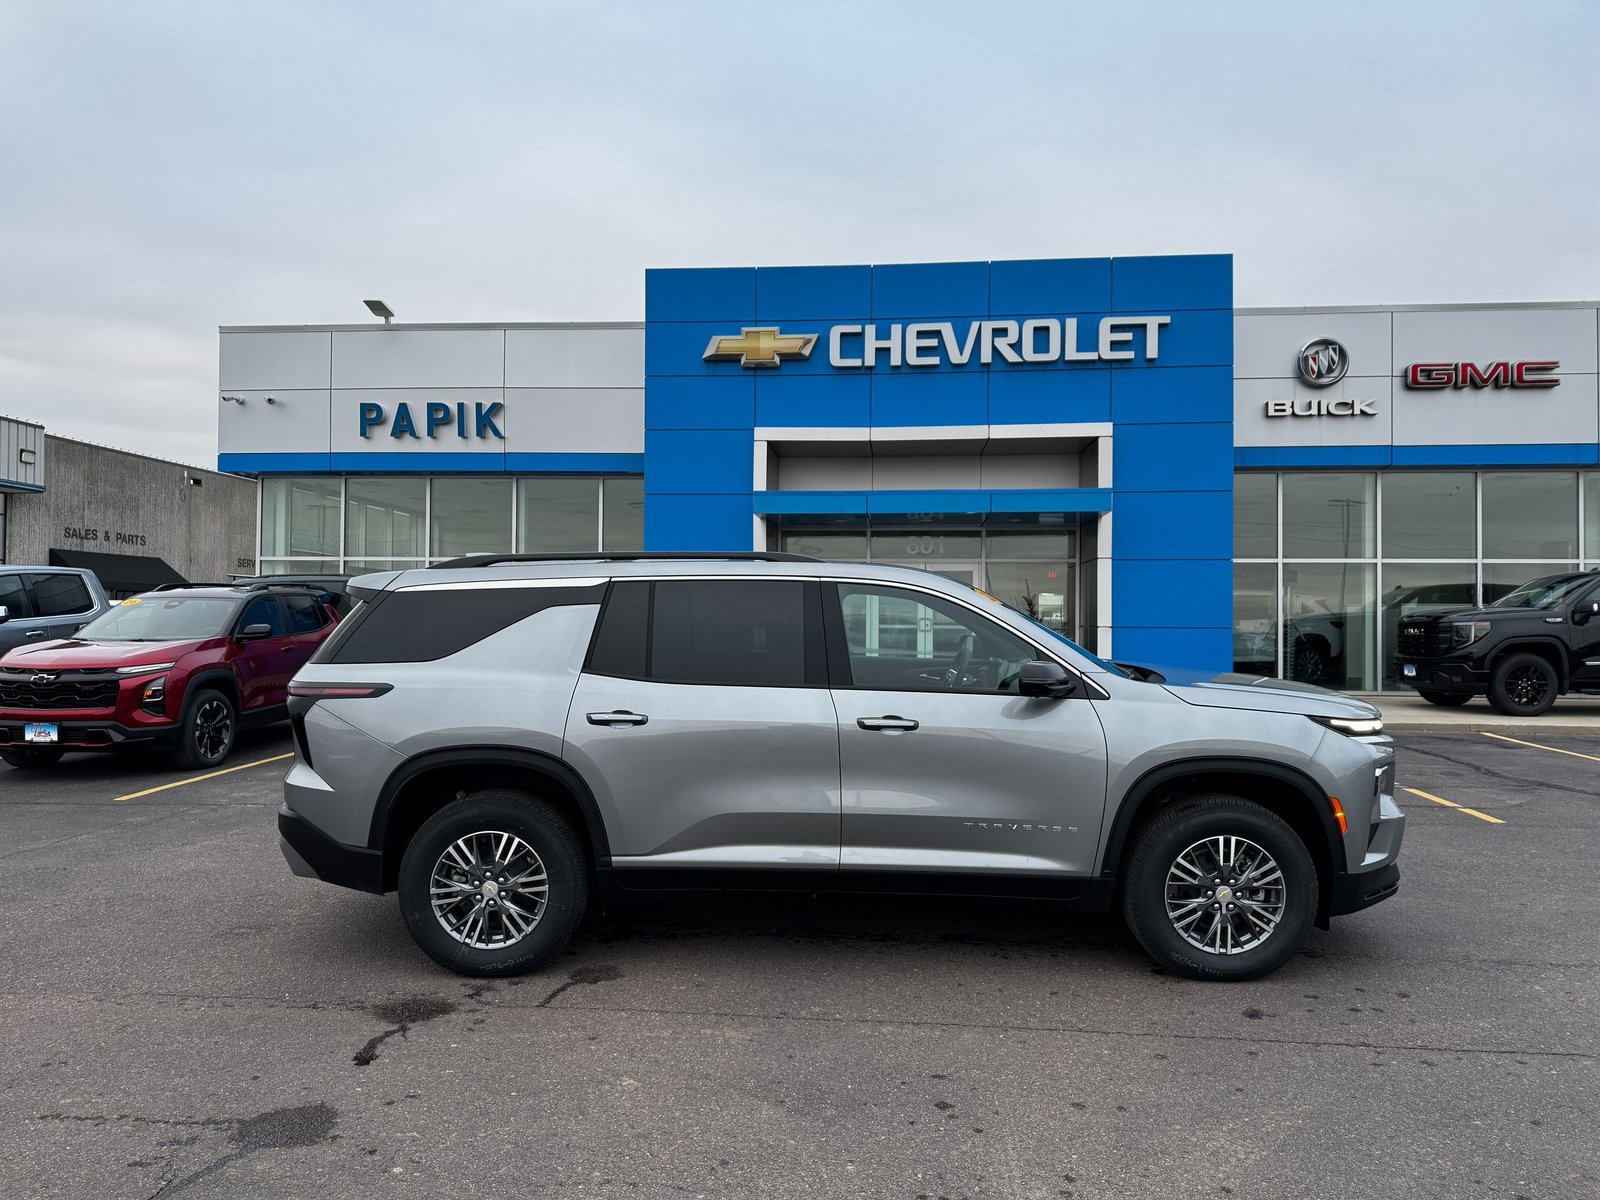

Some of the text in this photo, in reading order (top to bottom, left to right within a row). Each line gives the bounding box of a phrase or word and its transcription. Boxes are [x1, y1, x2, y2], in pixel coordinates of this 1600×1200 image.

[829, 315, 1171, 367] CHEVROLET
[1405, 360, 1561, 389] GMC
[359, 401, 505, 438] PAPIK
[1265, 399, 1379, 418] BUICK
[63, 526, 146, 546] SALES & PARTS
